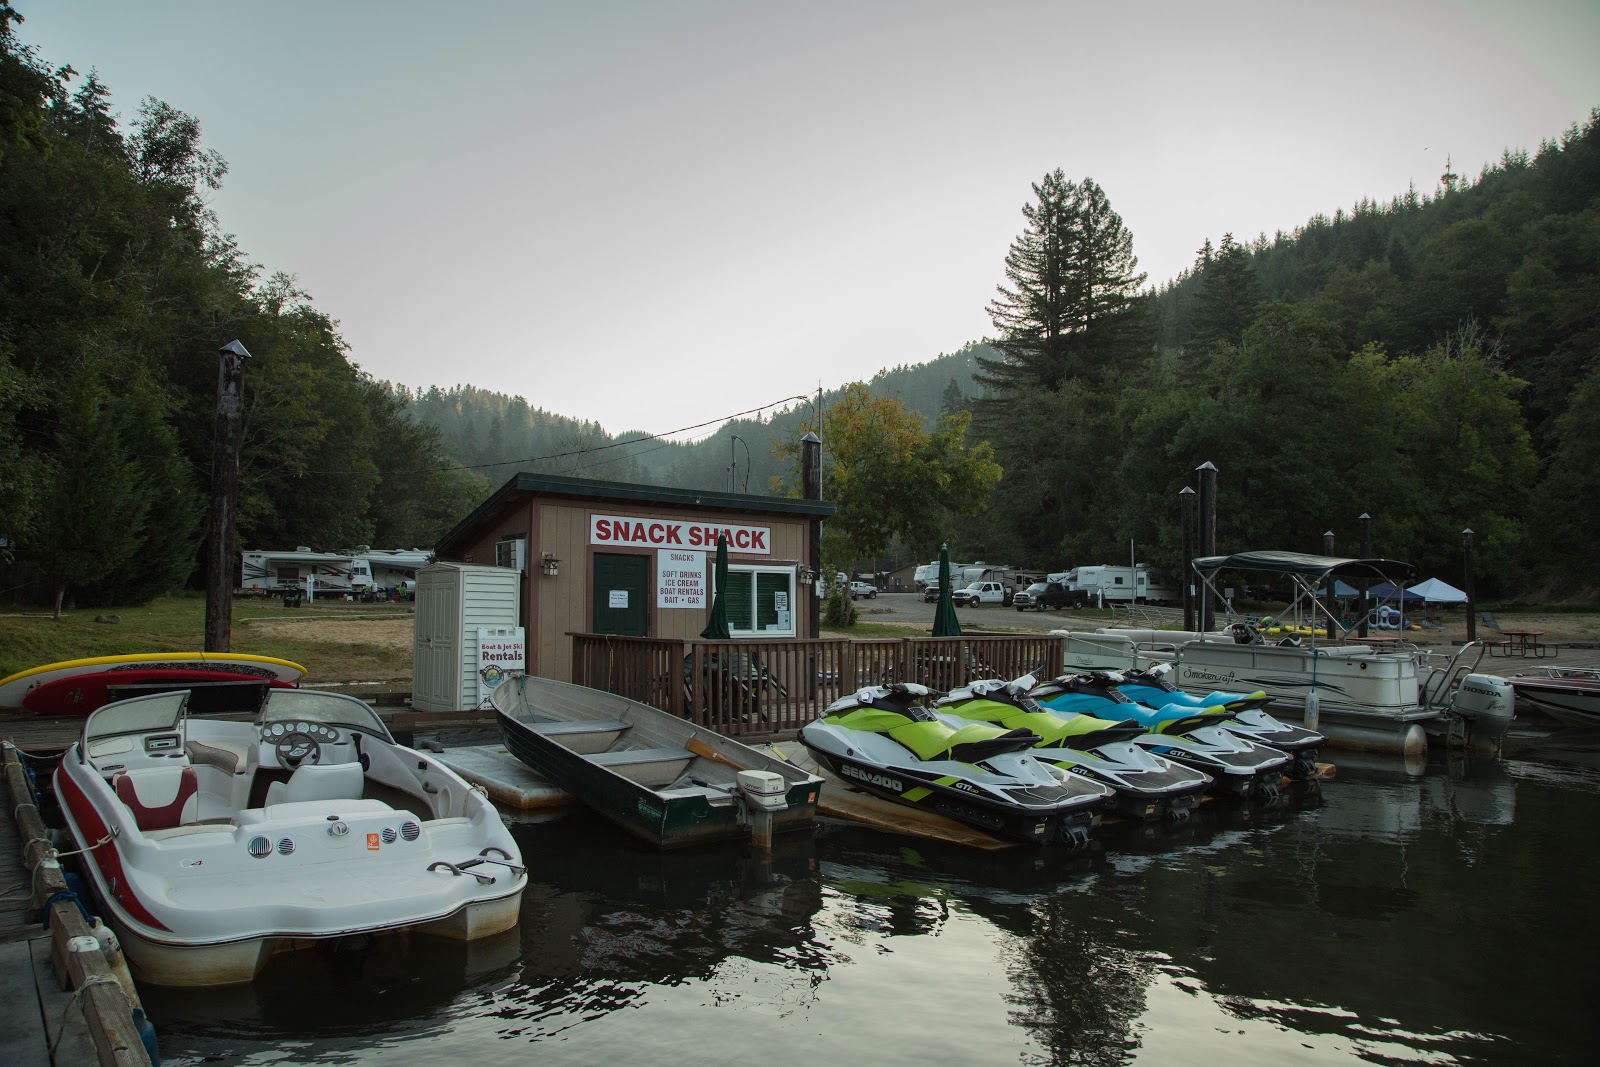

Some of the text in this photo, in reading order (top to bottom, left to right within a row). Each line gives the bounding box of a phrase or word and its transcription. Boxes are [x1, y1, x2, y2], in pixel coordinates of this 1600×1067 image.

[595, 519, 766, 549] SNACK SHACK
[670, 554, 694, 562] SNACKS
[482, 650, 522, 660] Rentals
[1463, 686, 1502, 697] HONDA
